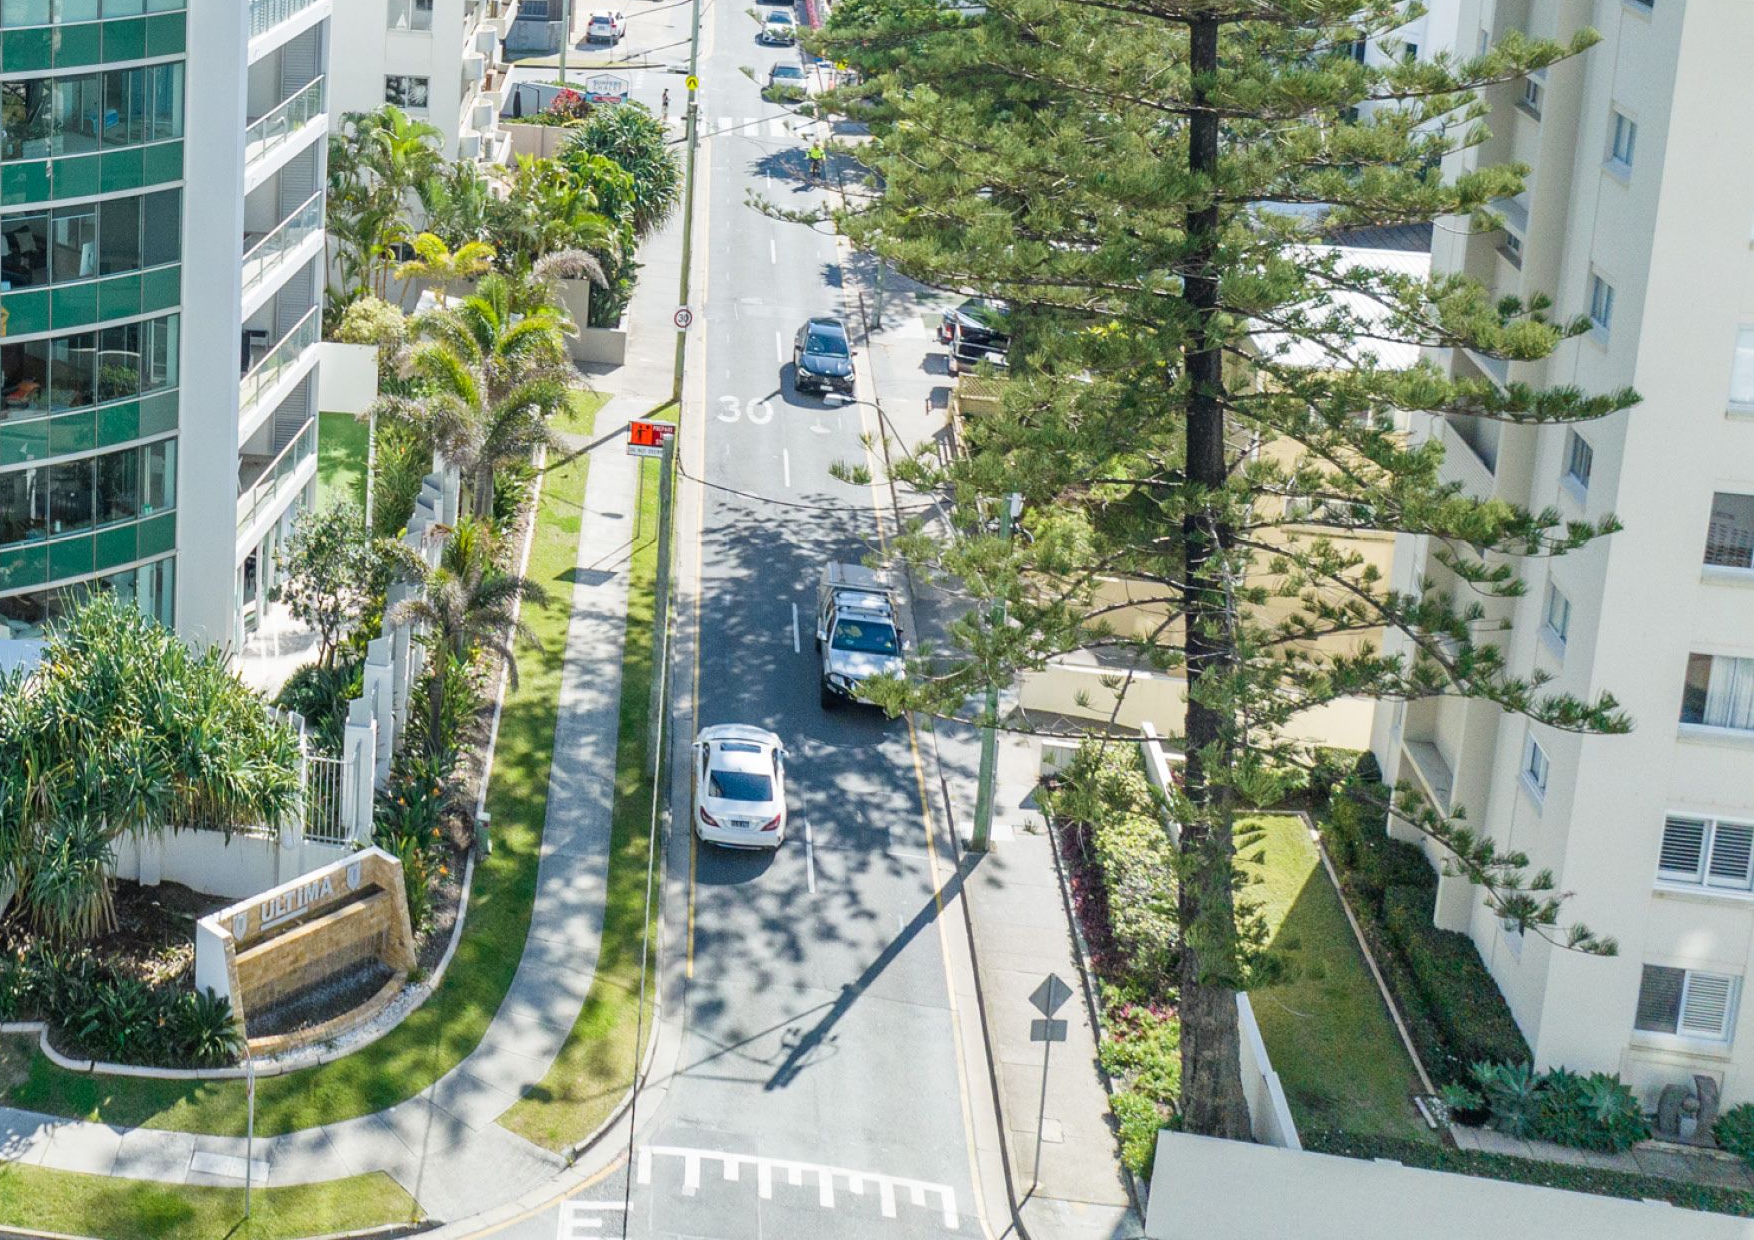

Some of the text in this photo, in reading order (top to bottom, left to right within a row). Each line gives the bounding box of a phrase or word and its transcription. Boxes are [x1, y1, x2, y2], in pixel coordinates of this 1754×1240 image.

[679, 313, 689, 322] 30
[717, 395, 774, 425] 30
[260, 875, 333, 922] ULTIMA
